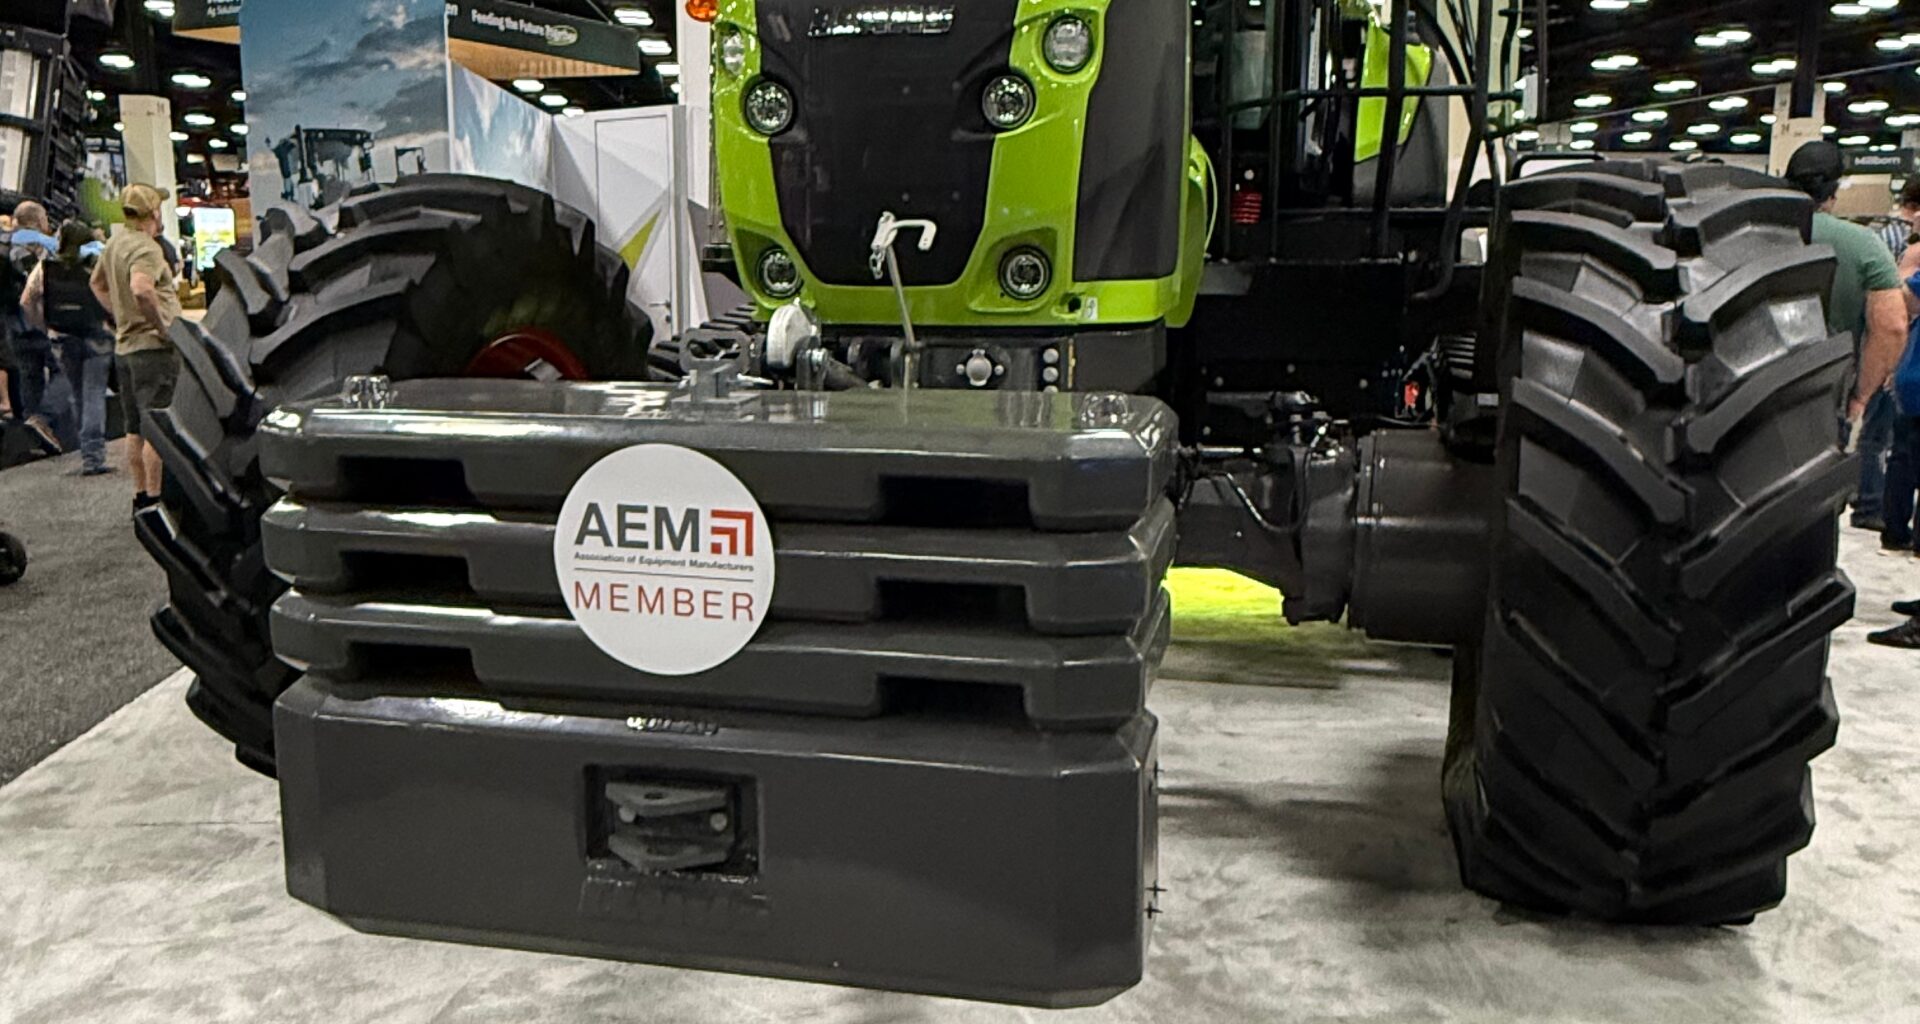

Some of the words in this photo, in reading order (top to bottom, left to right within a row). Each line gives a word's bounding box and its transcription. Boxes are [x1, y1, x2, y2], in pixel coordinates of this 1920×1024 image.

[471, 9, 505, 31] Feeding
[505, 17, 518, 30] the
[519, 19, 545, 36] Future
[574, 502, 700, 553] AEM
[574, 552, 625, 563] Association
[627, 555, 636, 564] of
[638, 556, 686, 568] Equipment
[689, 559, 754, 572] Manufacturers
[574, 580, 754, 622] MEMBER
